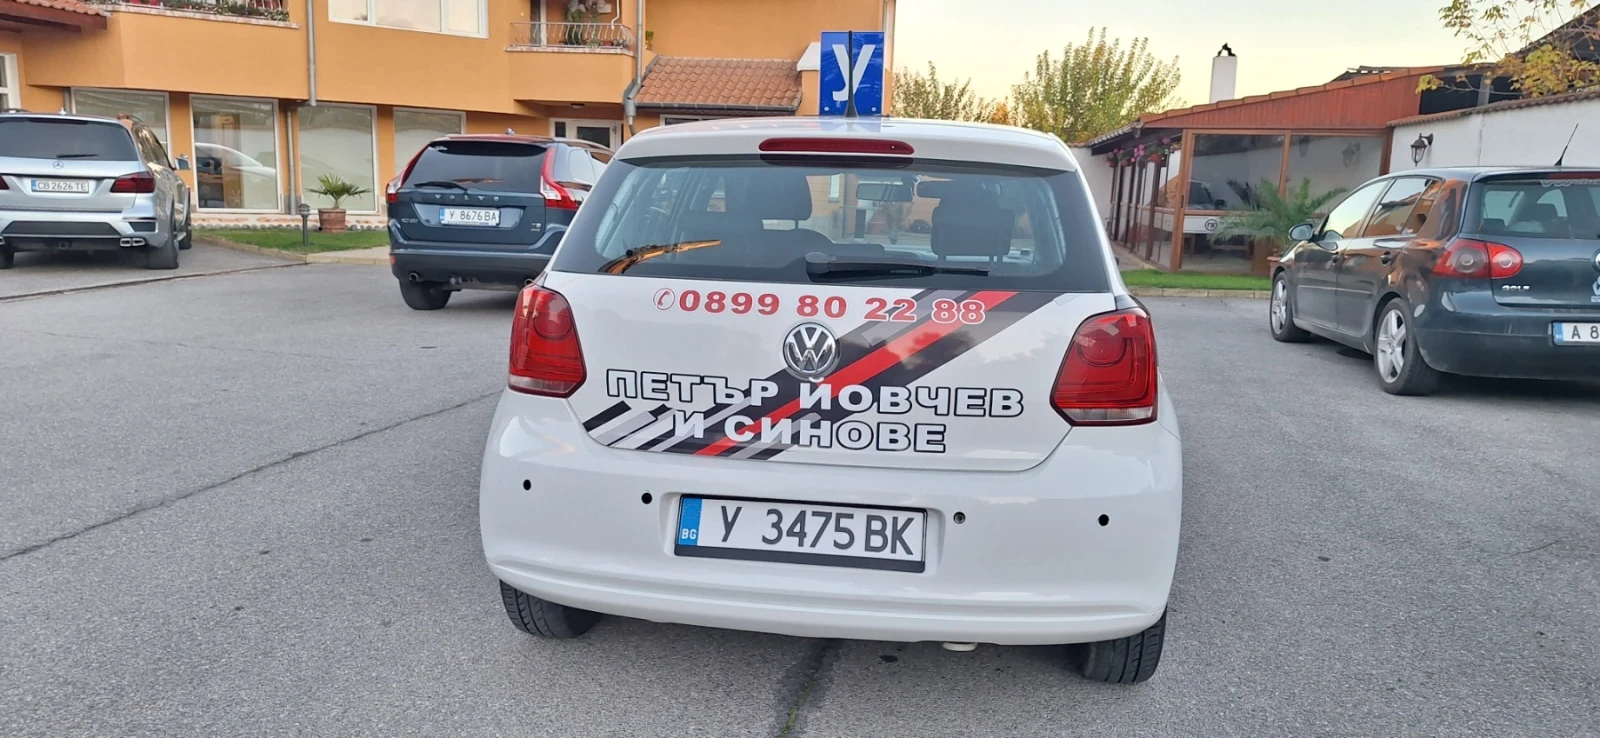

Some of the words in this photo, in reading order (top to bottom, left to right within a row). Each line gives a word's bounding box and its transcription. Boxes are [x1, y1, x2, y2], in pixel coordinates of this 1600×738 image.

[52, 182, 73, 190] 2626
[460, 211, 483, 220] 8676
[678, 289, 780, 316] 0899
[796, 294, 847, 319] 80
[863, 297, 917, 322] 22
[931, 299, 986, 324] 88
[606, 369, 779, 407] ПЕТЪР
[799, 376, 1024, 417] ЙОВЧЕВ
[673, 409, 705, 439] И
[724, 415, 947, 453] СИНОВЕ
[681, 528, 697, 540] BG
[761, 508, 855, 550] 3475
